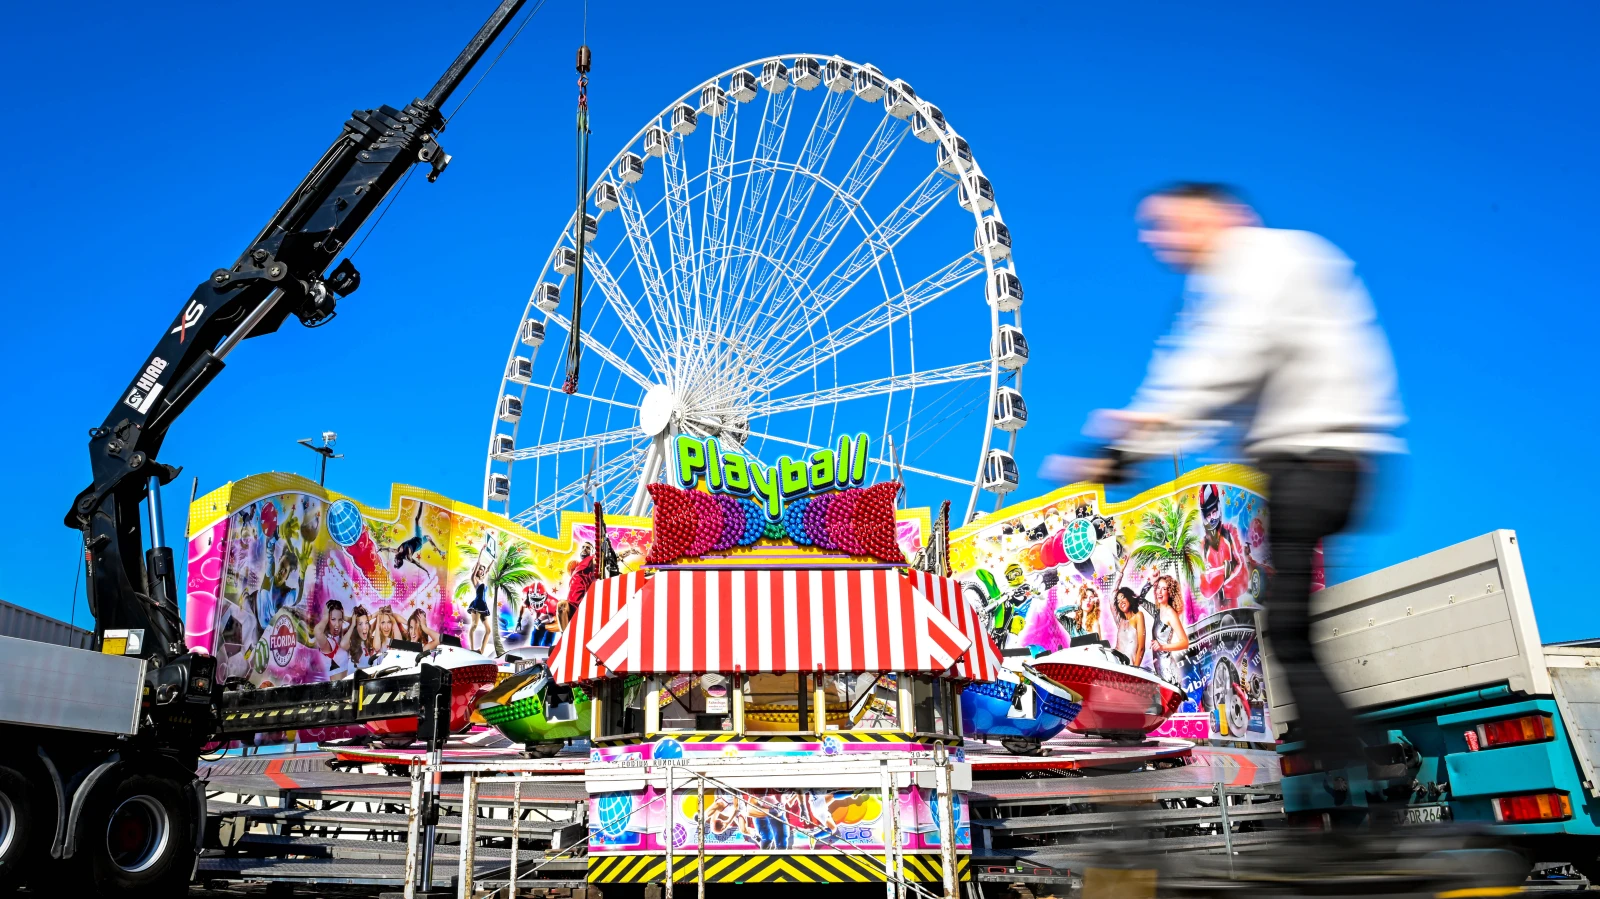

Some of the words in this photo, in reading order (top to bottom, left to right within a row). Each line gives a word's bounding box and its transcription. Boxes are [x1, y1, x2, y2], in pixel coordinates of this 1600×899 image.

[136, 356, 168, 392] HIAB
[676, 433, 869, 520] Playball
[270, 634, 296, 648] FLORIDA
[1230, 643, 1243, 659] 160
[621, 760, 648, 768] PODIUM
[1409, 809, 1423, 824] DR
[1423, 807, 1442, 823] 264
